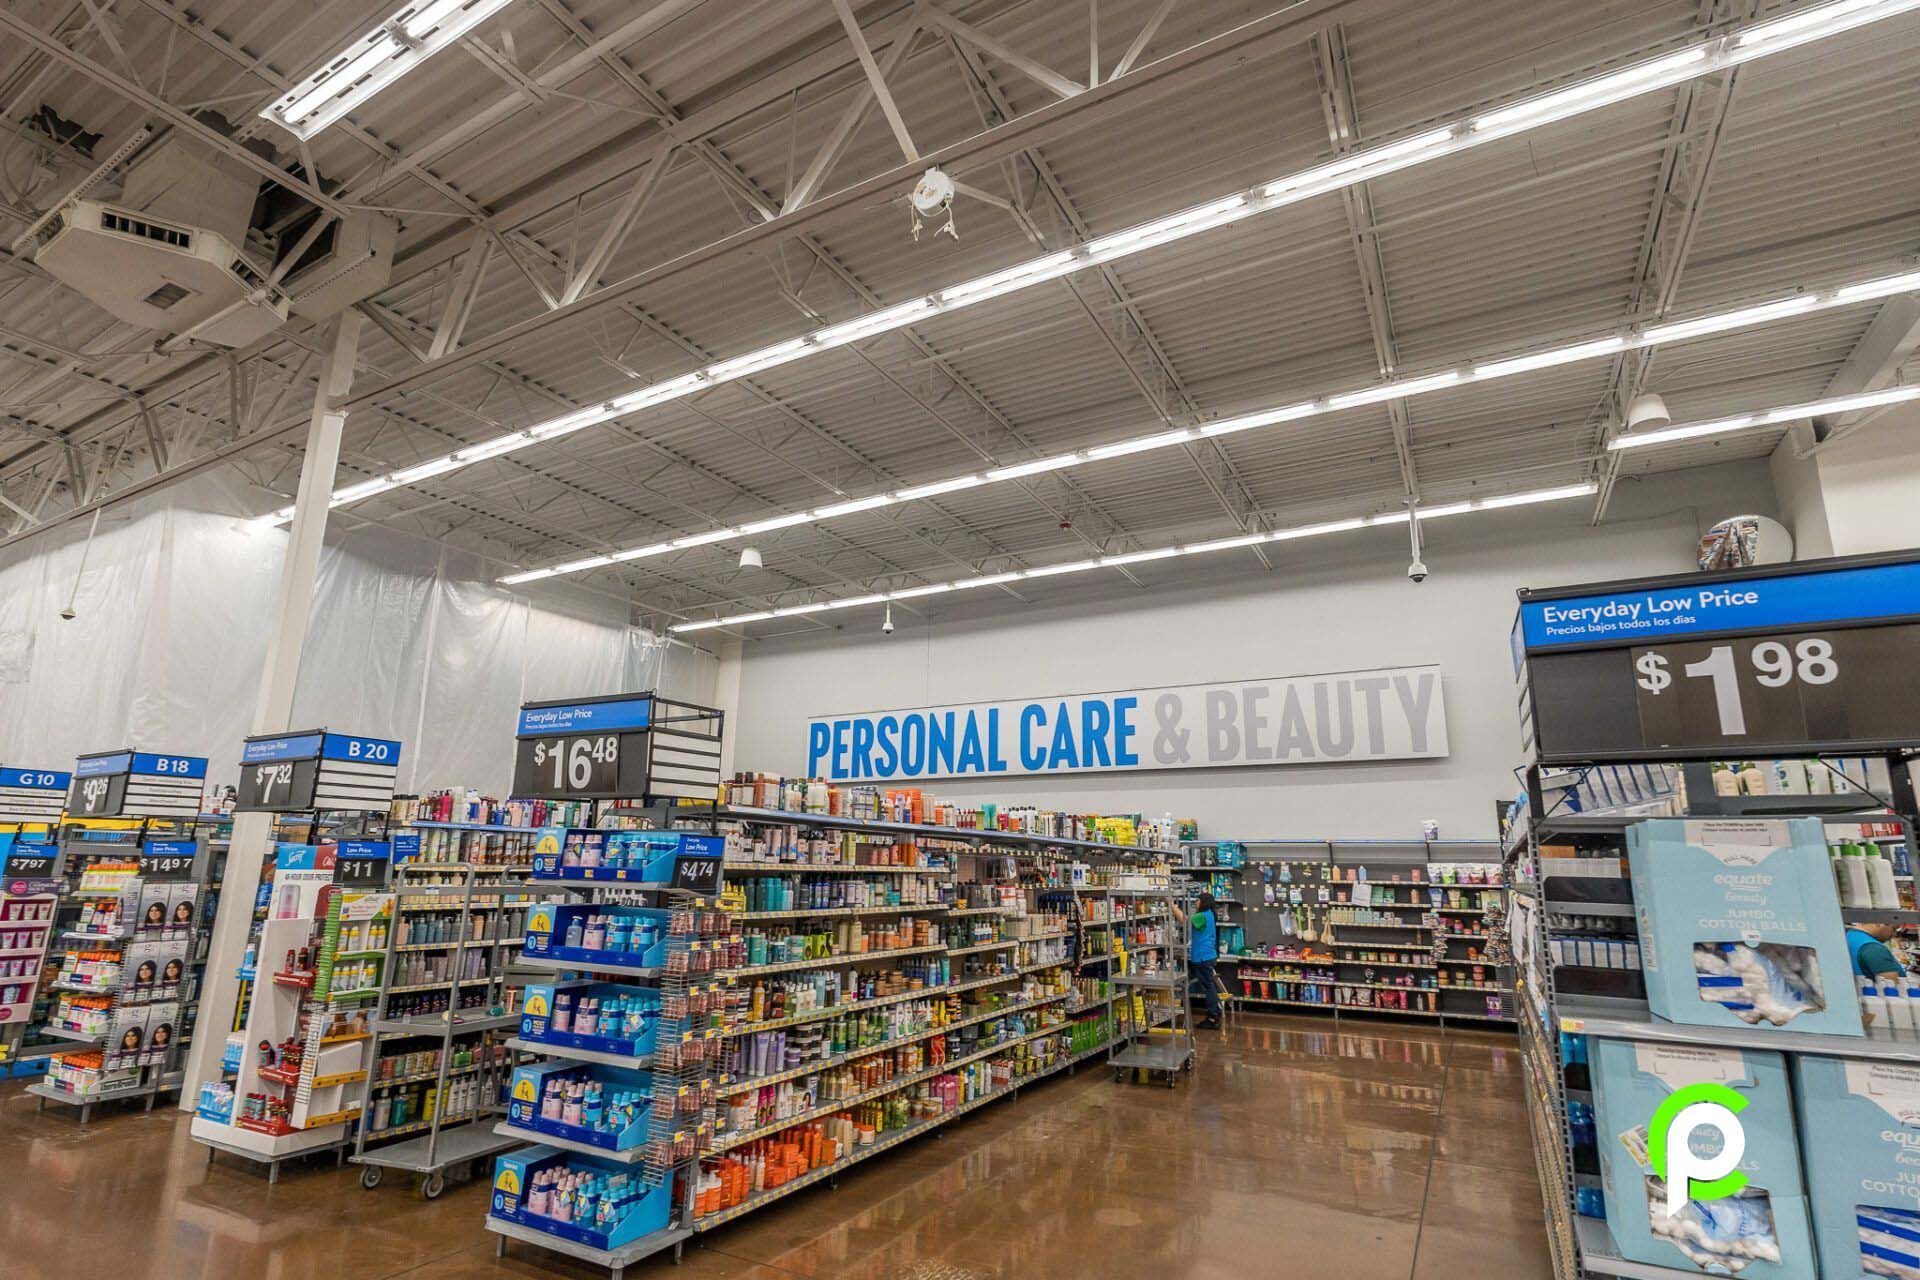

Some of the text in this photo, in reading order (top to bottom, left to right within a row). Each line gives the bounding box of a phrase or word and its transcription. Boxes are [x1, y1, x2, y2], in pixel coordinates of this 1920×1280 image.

[1543, 590, 1760, 624] Everyday Low Price
[1546, 625, 1586, 636] Precios
[1588, 622, 1617, 634] bajos
[1619, 619, 1651, 630] todos
[1654, 616, 1671, 626] los
[526, 708, 593, 724] Everyday Low Price
[808, 673, 1435, 779] PERSONAL CARE & BEAUTY
[349, 741, 388, 760] B 20
[156, 758, 190, 773] B 18
[19, 773, 55, 786] G 10
[1713, 873, 1773, 888] equate
[1728, 908, 1775, 920] JUMBO
[1699, 919, 1809, 932] COTTON BALLS
[1862, 1179, 1920, 1200] COTTO
